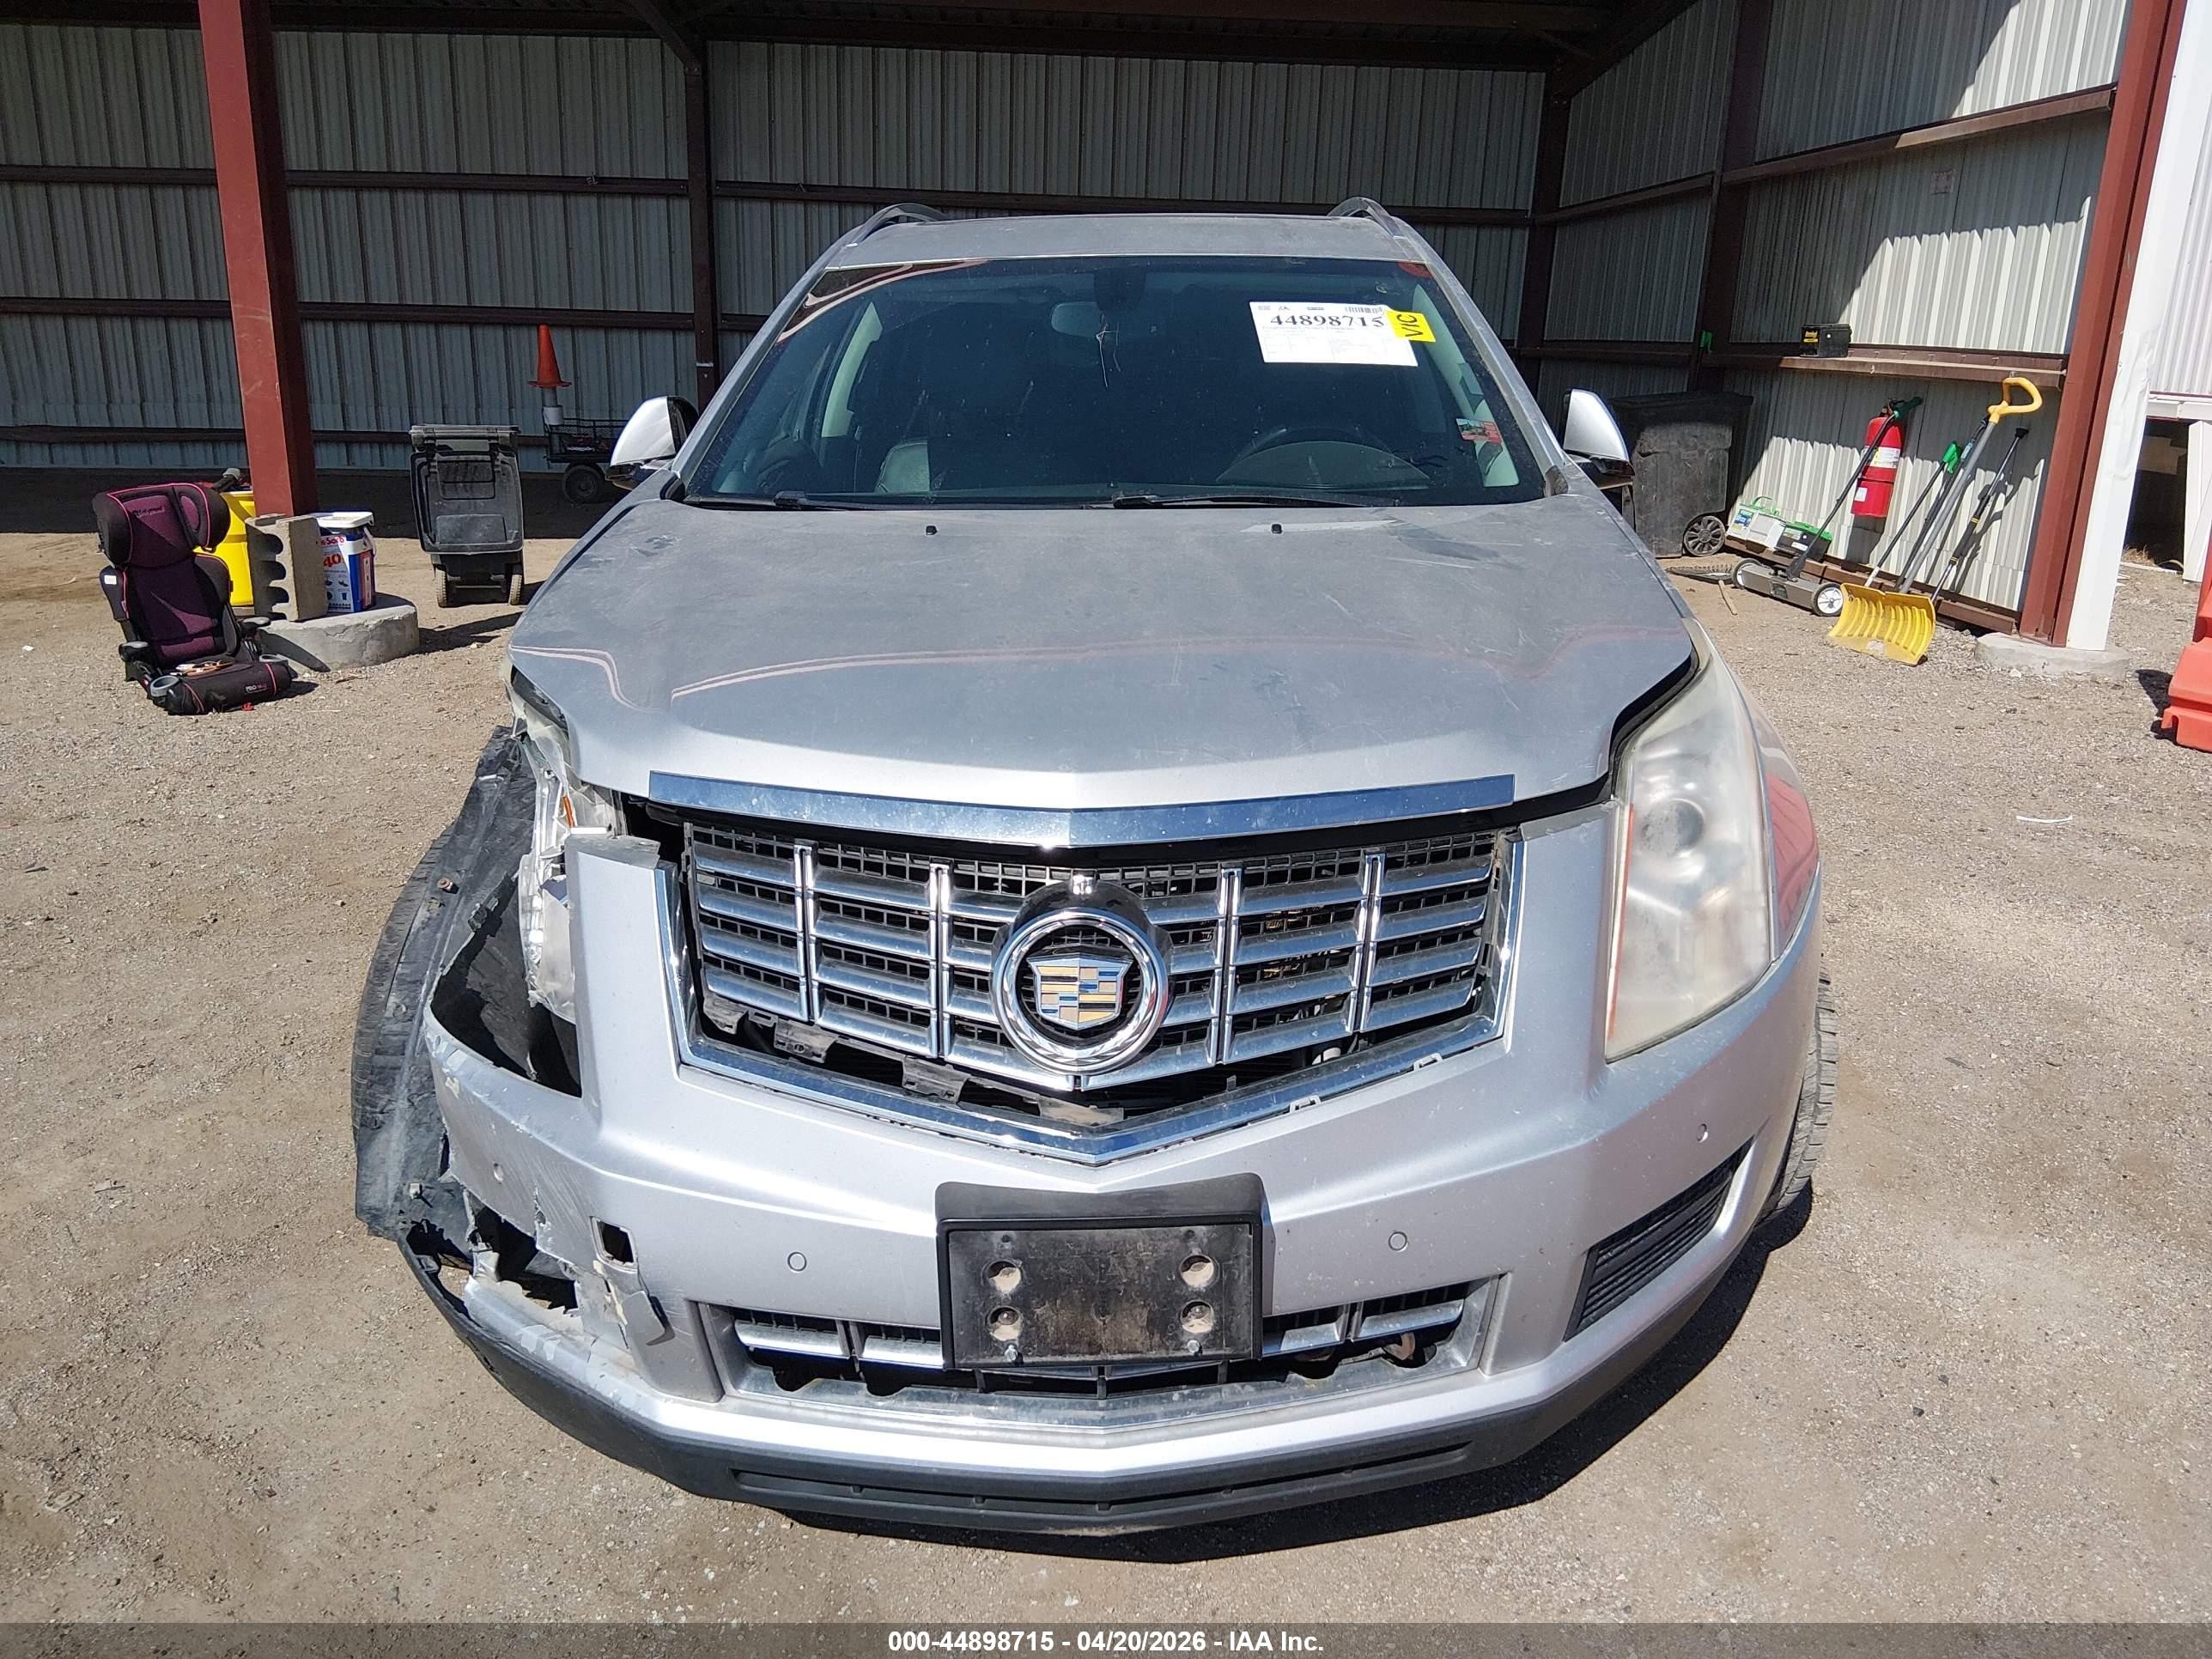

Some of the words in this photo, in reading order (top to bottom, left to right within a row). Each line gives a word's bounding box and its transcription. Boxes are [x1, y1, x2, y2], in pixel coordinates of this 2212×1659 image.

[1270, 314, 1385, 328] 44898715
[1396, 314, 1423, 337] VIC
[324, 555, 341, 567] 40
